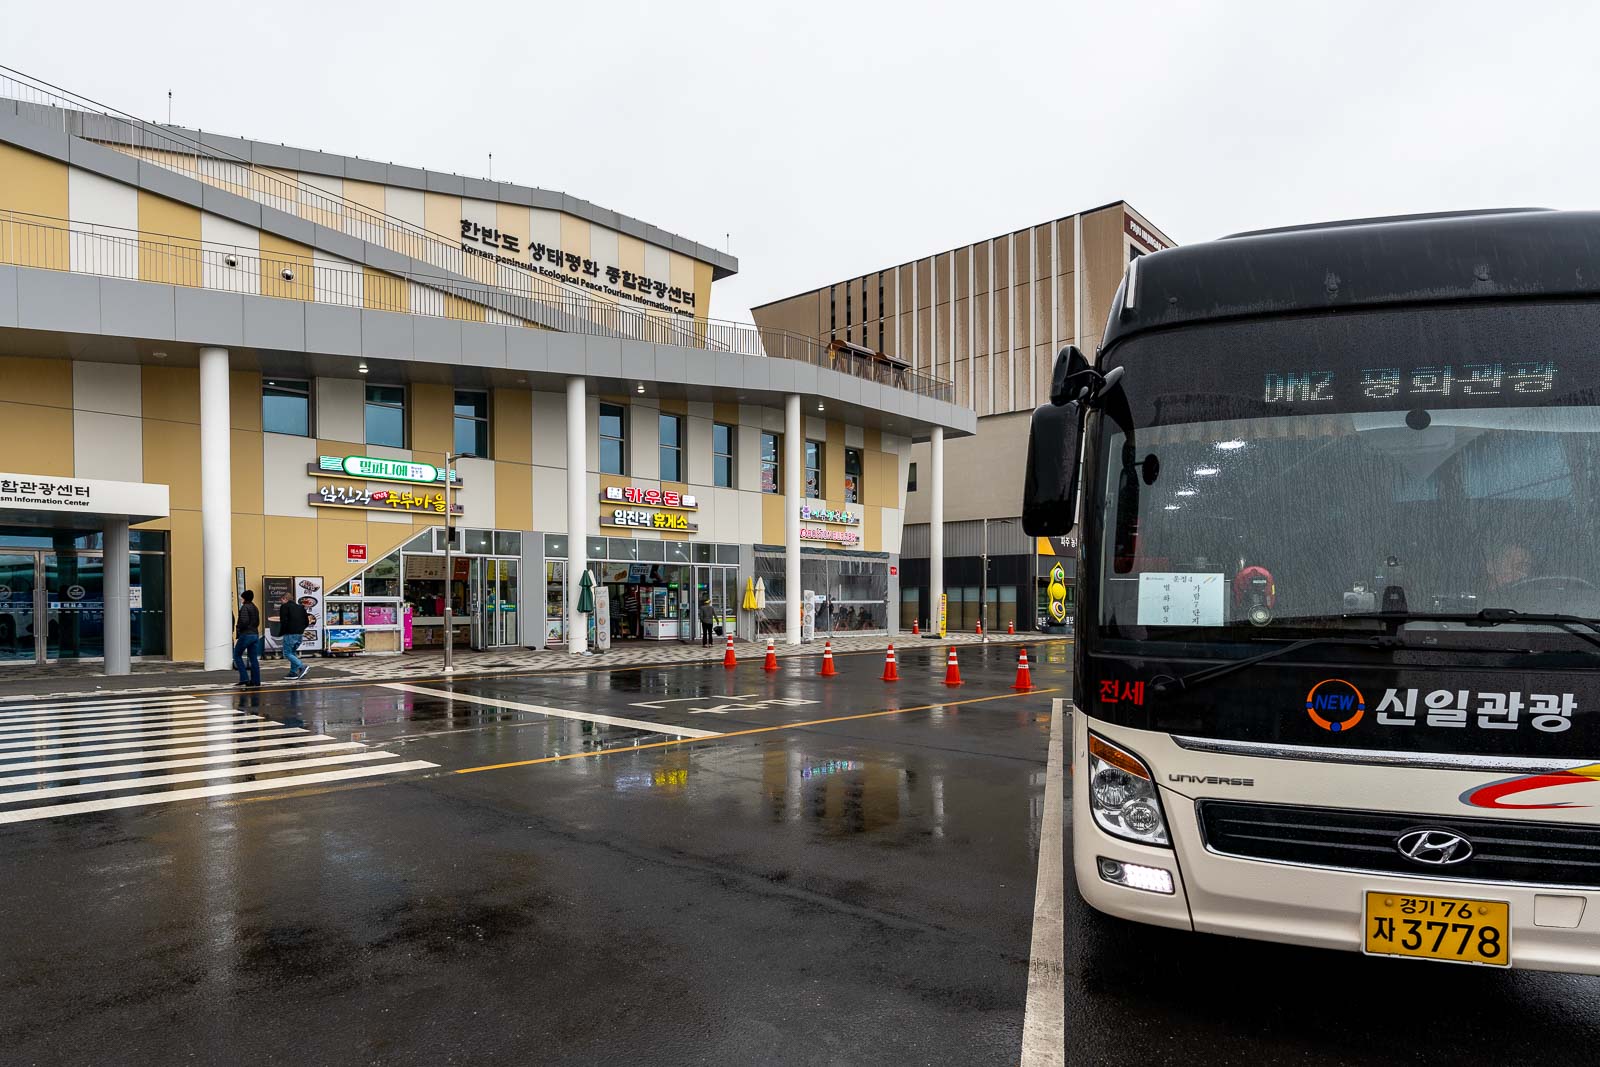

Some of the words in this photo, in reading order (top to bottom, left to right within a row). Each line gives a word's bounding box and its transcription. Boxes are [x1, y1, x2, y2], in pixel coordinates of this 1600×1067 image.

[460, 219, 520, 253] 한반도
[528, 242, 599, 277] 생태평화
[605, 265, 695, 307] 종합관광센터
[461, 243, 494, 260] Korean
[495, 254, 538, 273] peninsula
[539, 267, 579, 285] Ecological
[581, 278, 603, 292] Peace
[603, 285, 632, 301] Tourism
[633, 294, 673, 312] Information
[674, 306, 695, 319] Center
[1265, 371, 1334, 402] DMZ
[1360, 361, 1558, 399] 평화관광
[1, 480, 90, 498] 합관광센터
[320, 484, 373, 505] 임진각
[385, 489, 447, 513] 두부마을
[624, 486, 680, 507] 카우돈
[14, 496, 63, 505] Information
[64, 499, 90, 507] Center
[614, 509, 652, 527] 임진각
[653, 512, 689, 529] 휴게소
[1100, 679, 1145, 706] 전세
[1314, 694, 1355, 711] NEW
[1375, 688, 1577, 733] 신일관광
[1168, 773, 1255, 787] UNIVERSE
